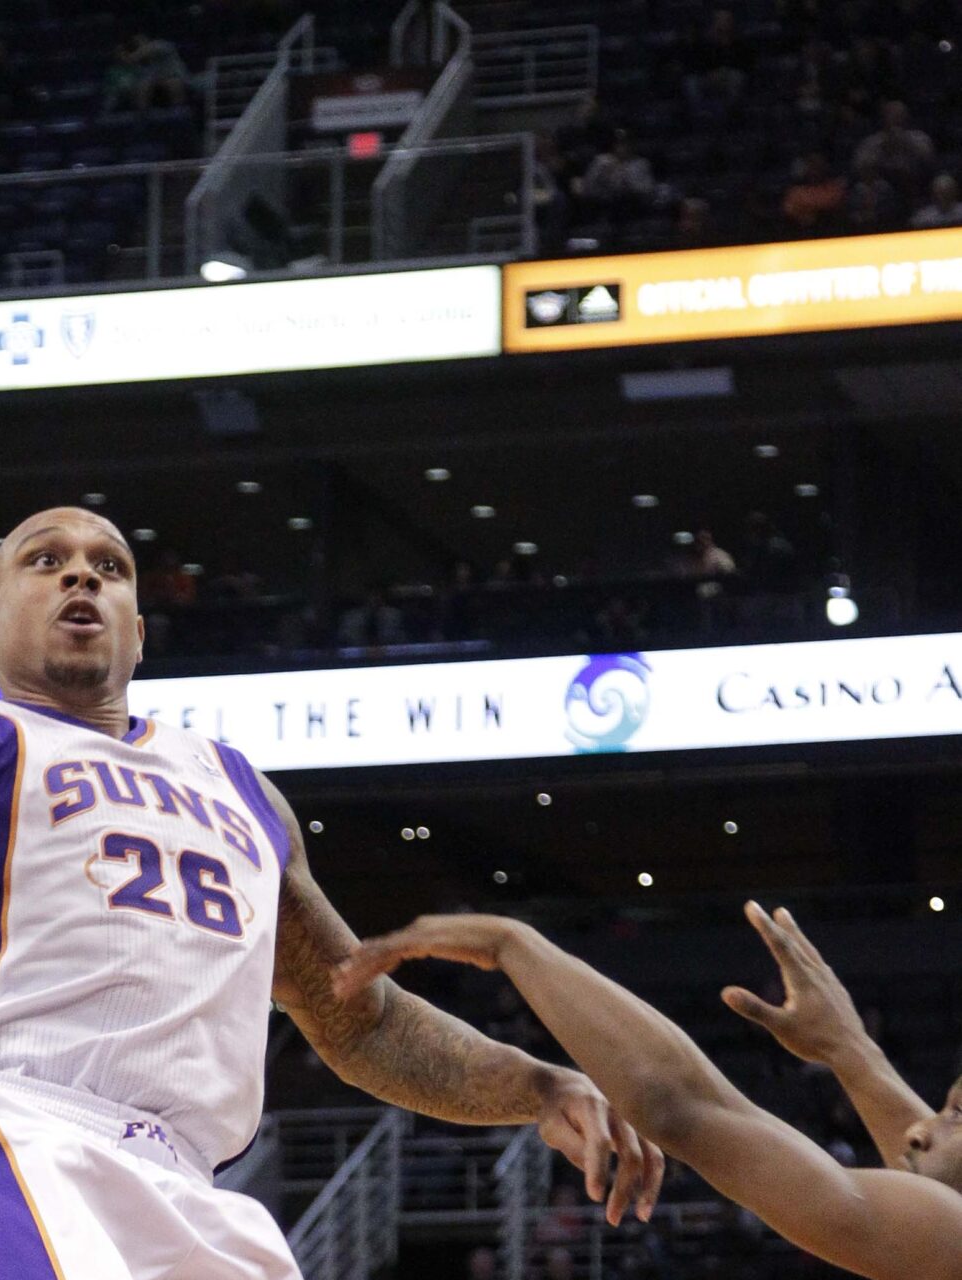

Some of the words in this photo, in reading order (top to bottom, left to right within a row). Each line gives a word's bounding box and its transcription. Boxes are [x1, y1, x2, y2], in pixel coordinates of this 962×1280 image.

[275, 698, 362, 740] THE
[405, 693, 503, 734] WIN
[43, 760, 263, 872] SUNS
[98, 831, 246, 942] 26
